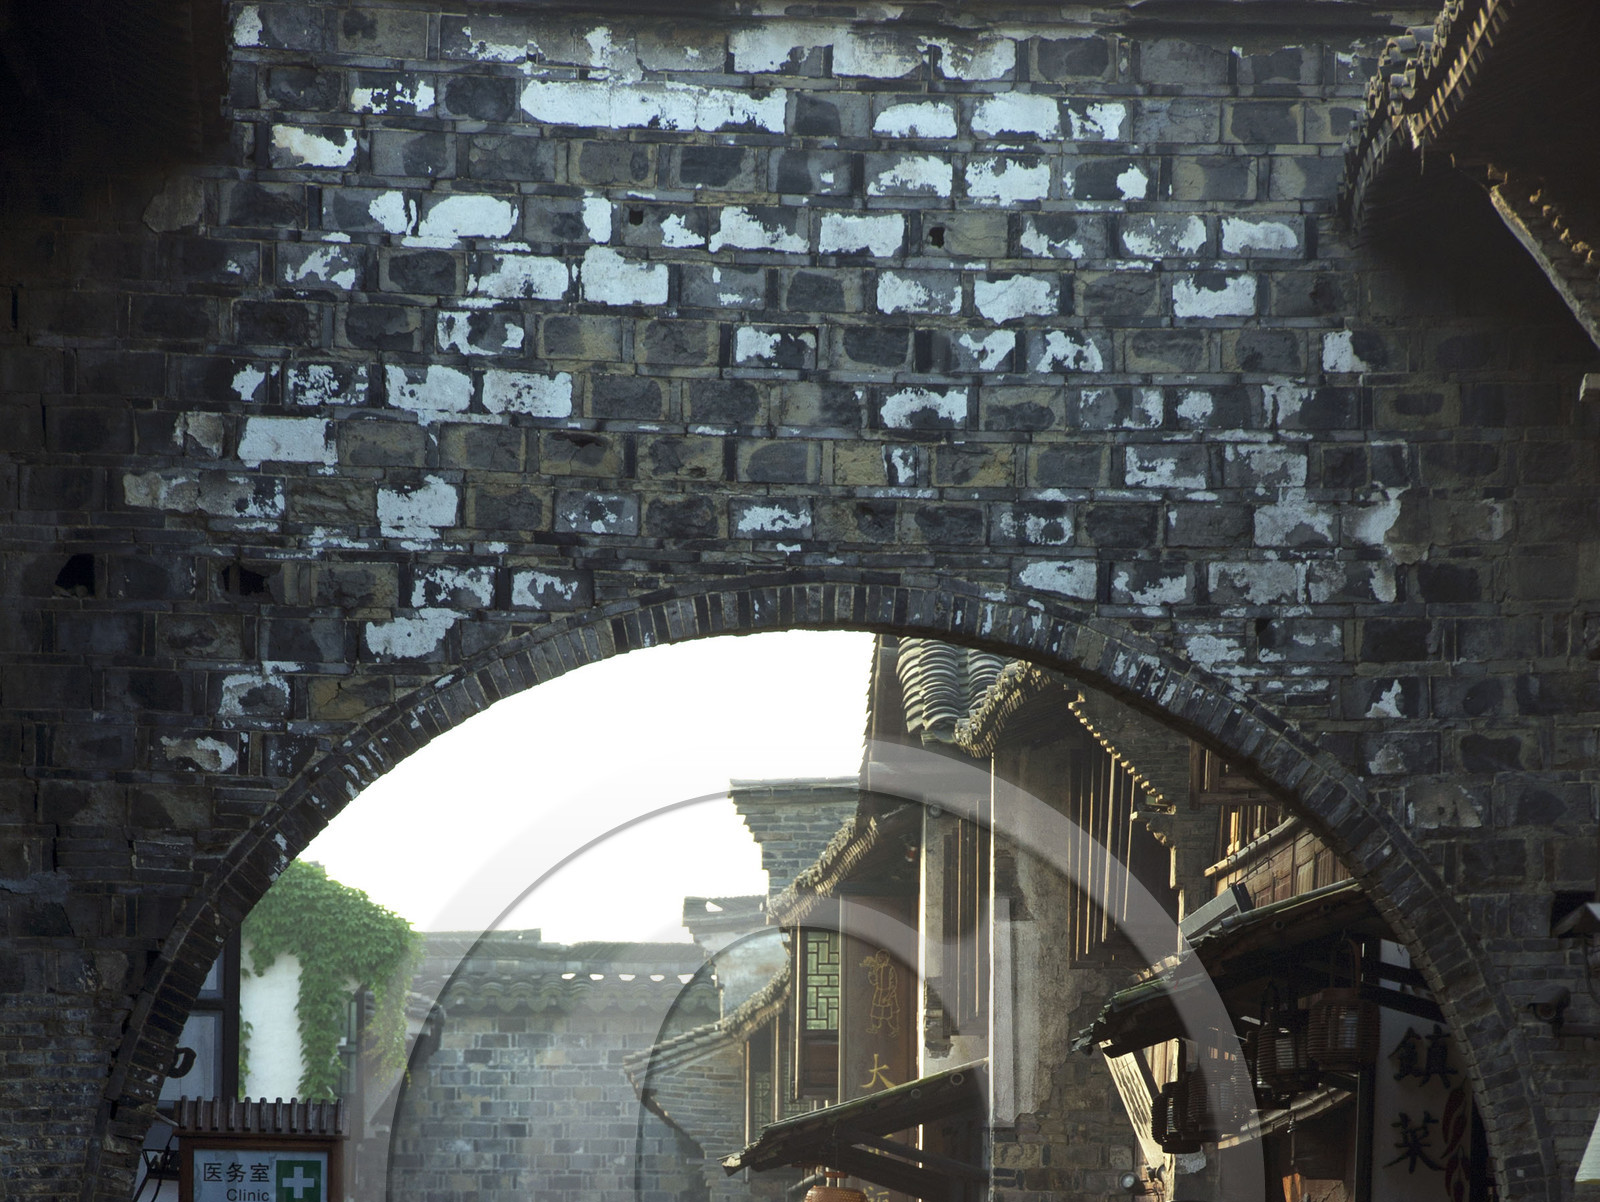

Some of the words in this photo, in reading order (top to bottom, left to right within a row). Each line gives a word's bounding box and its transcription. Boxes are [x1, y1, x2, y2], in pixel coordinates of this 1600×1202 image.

[203, 1161, 271, 1184] 医务室
[226, 1188, 270, 1202] Clinic
